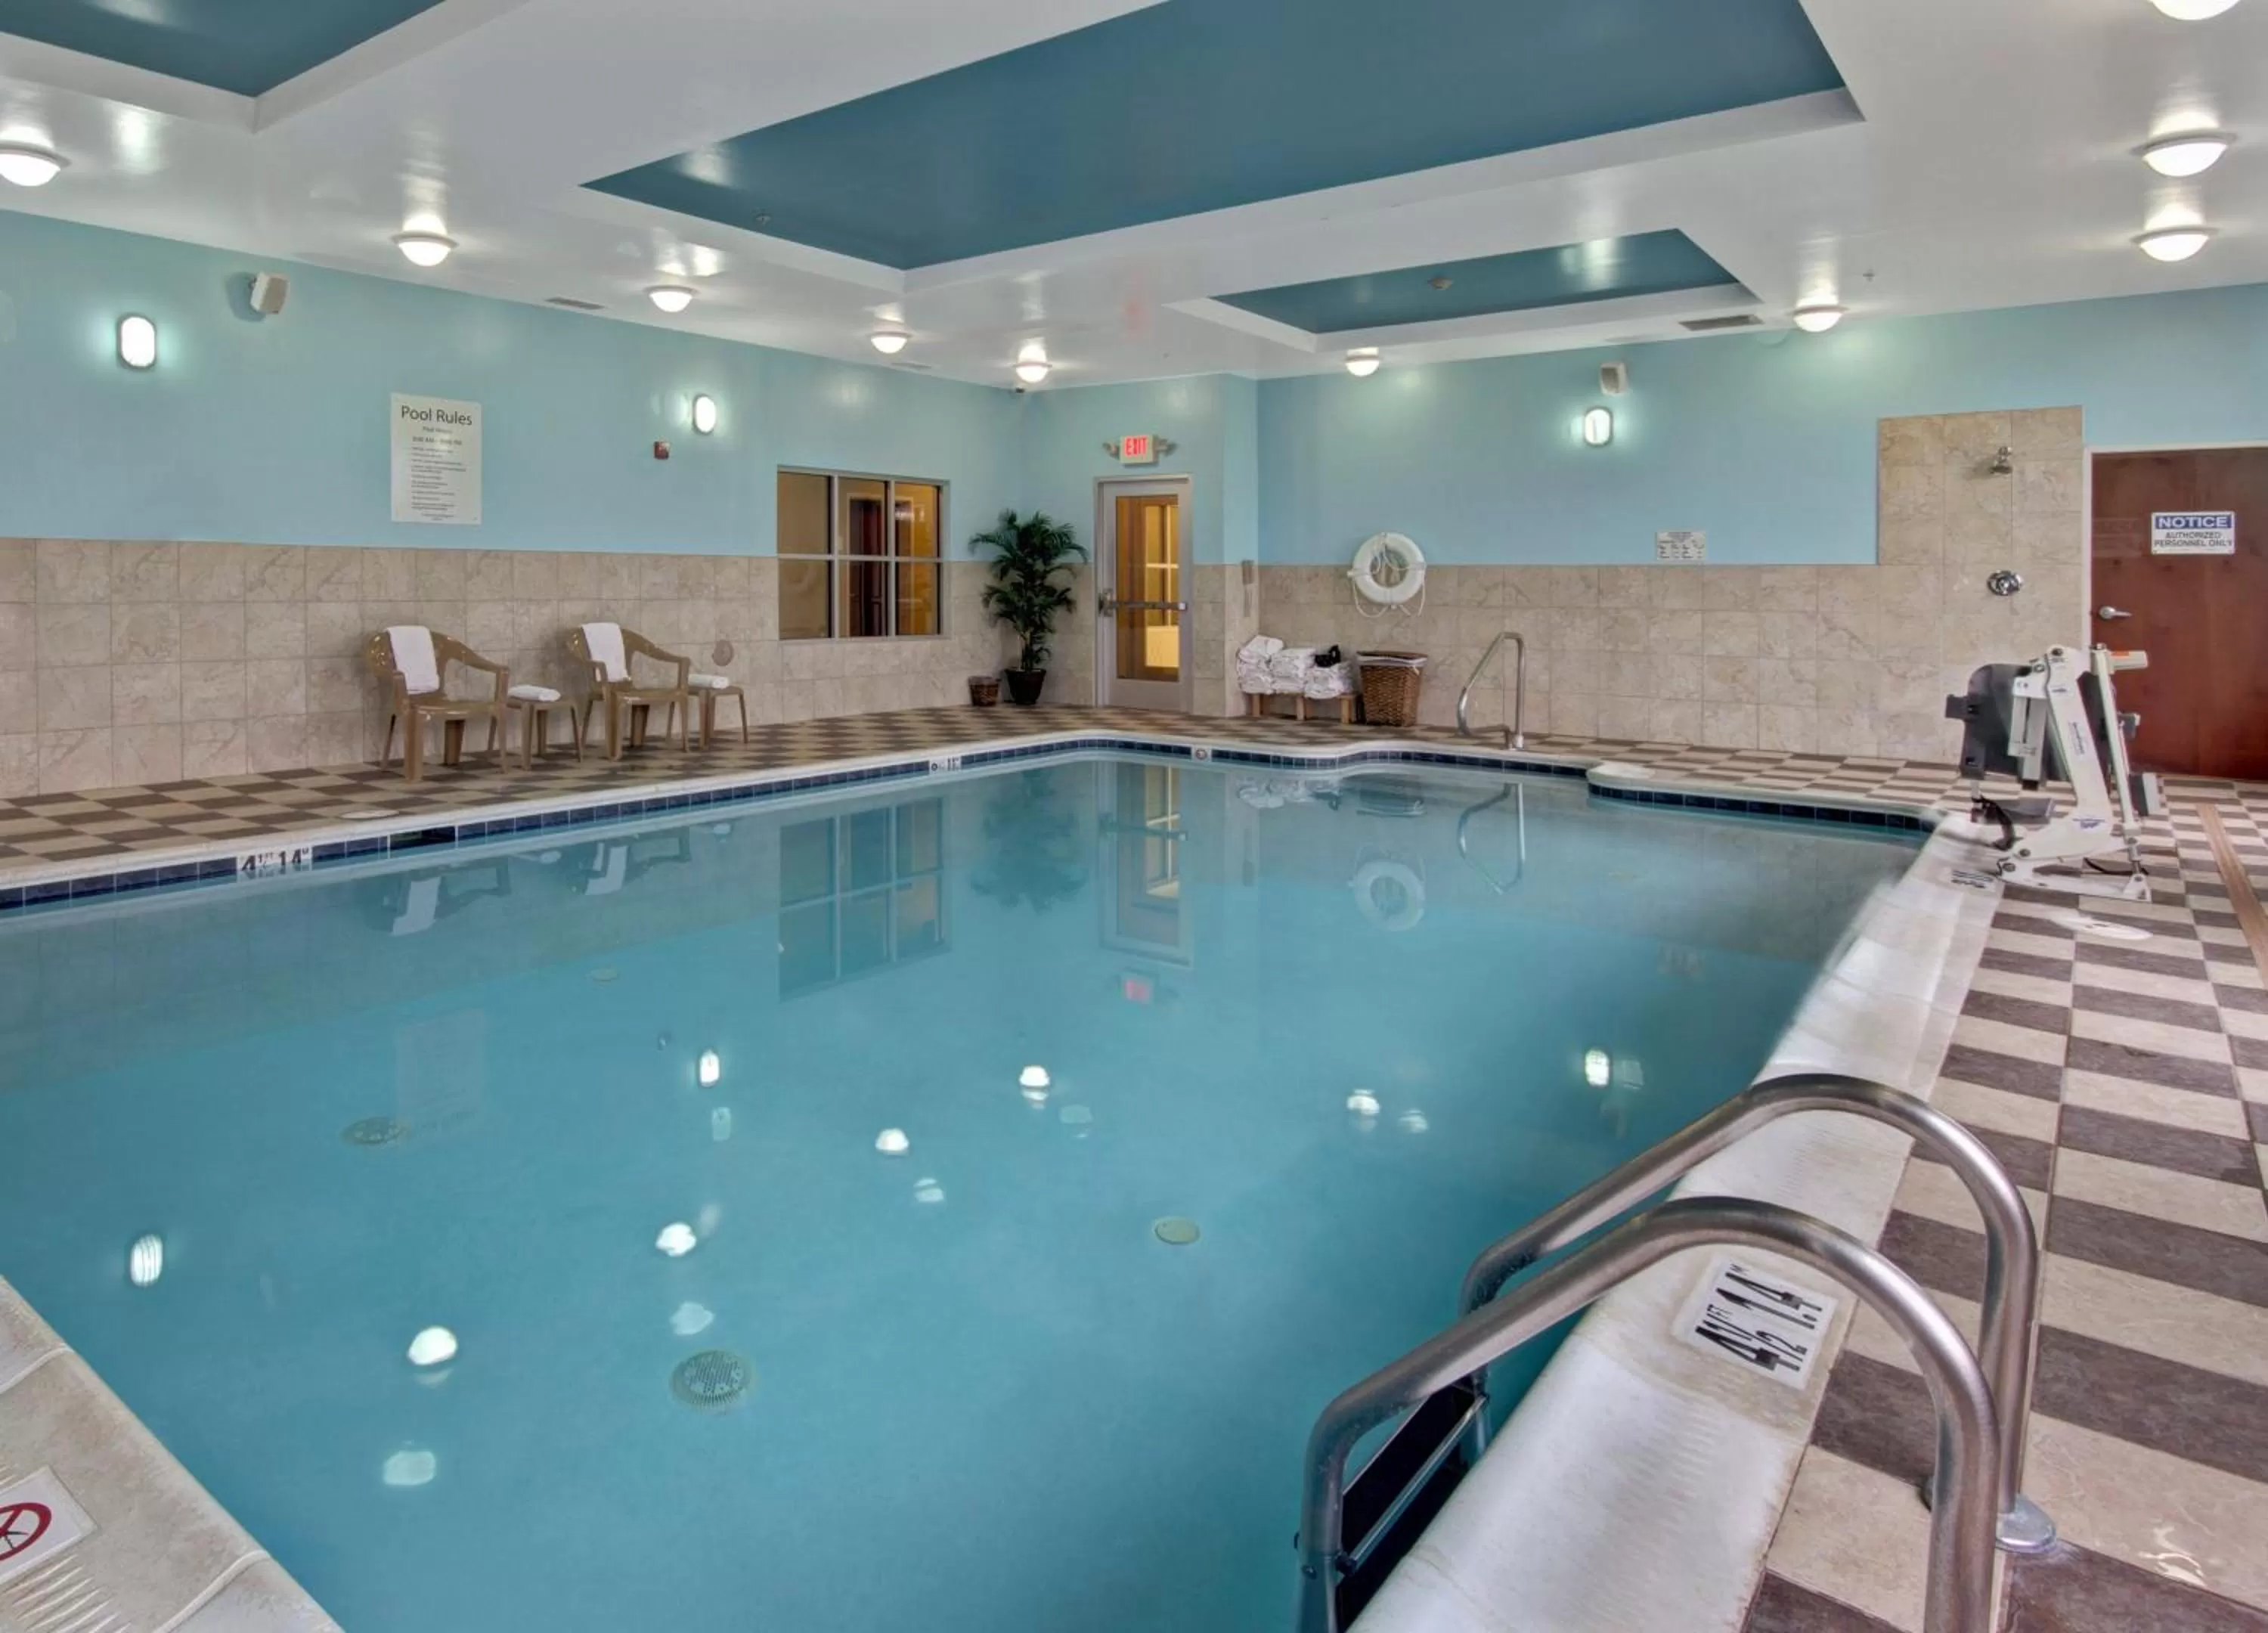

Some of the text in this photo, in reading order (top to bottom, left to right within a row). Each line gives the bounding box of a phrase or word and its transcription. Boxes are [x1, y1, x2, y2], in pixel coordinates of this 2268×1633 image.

[401, 405, 472, 426] Pool Rules
[1124, 436, 1147, 457] EXIT
[2158, 516, 2228, 528] NOTICE
